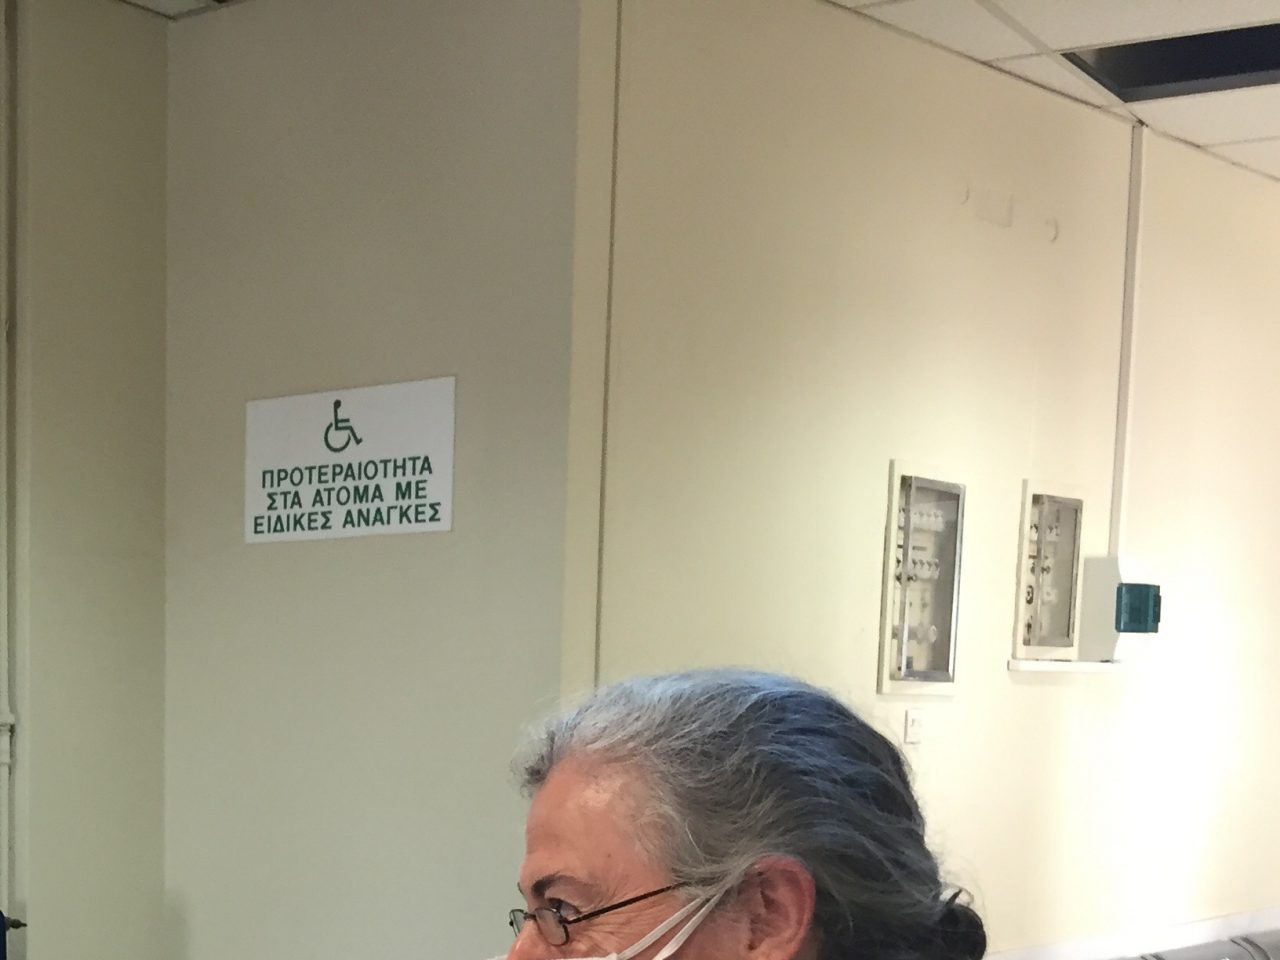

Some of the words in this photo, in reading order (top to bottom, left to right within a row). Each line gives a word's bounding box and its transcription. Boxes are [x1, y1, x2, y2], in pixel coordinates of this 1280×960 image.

[261, 455, 433, 489] ΠΡΟΤΕΡΑΙΟΤΗΤΑ
[266, 490, 303, 511] ΣΤΑ
[311, 483, 385, 507] ΑΤΟΜΑ
[395, 479, 428, 502] ΜΕ
[253, 510, 333, 535] ΕΙΔΙΚΕΣ
[342, 502, 442, 529] ΑΝΑΓΚΕΣ
